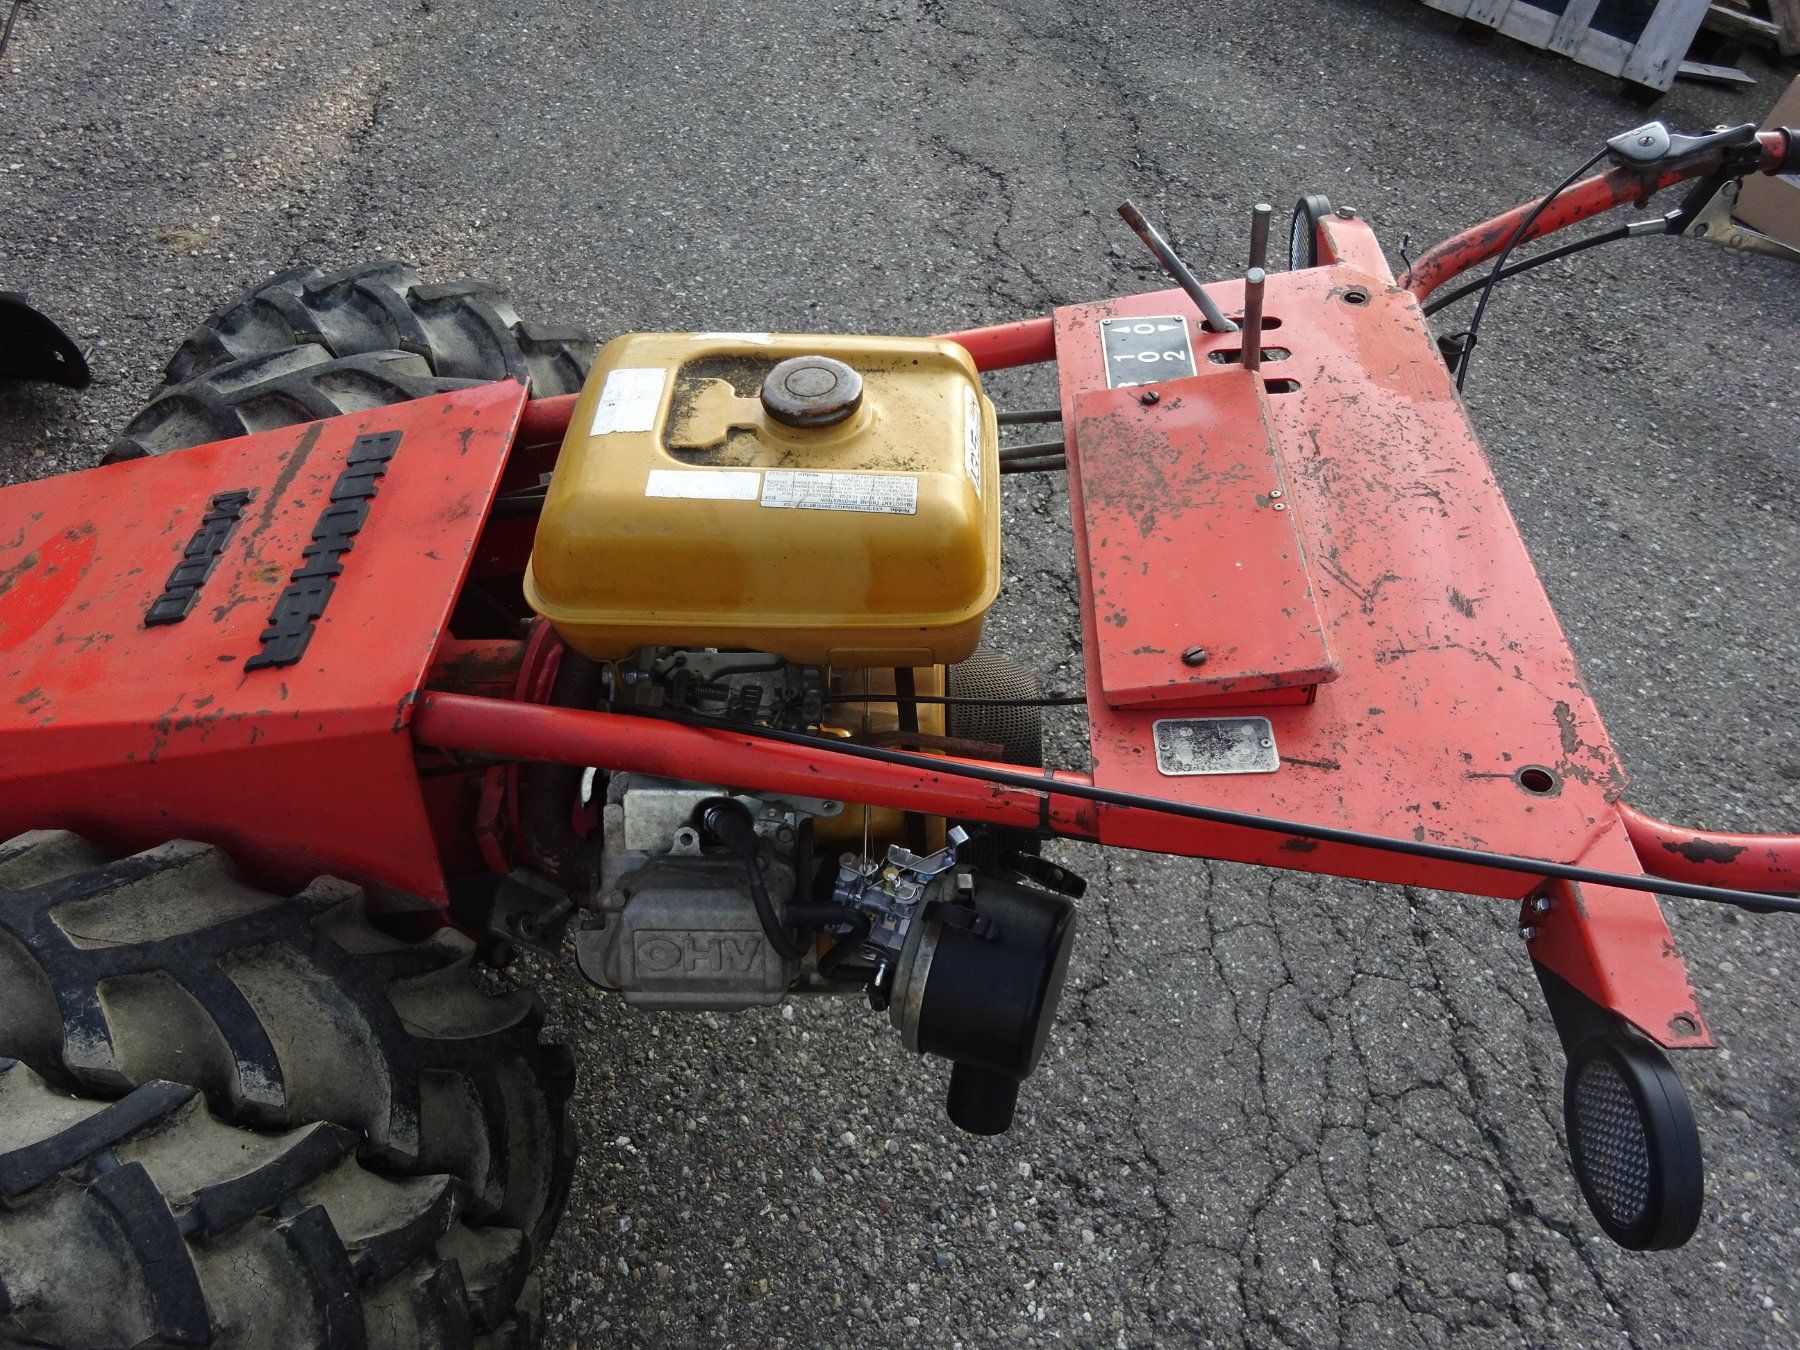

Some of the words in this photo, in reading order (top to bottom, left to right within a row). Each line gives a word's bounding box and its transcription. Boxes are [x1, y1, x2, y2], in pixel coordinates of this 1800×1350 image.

[1113, 354, 1136, 362] 1
[1138, 352, 1160, 362] 0
[1162, 350, 1186, 361] 2
[244, 429, 403, 673] BUCHER
[638, 937, 762, 972] OHV
